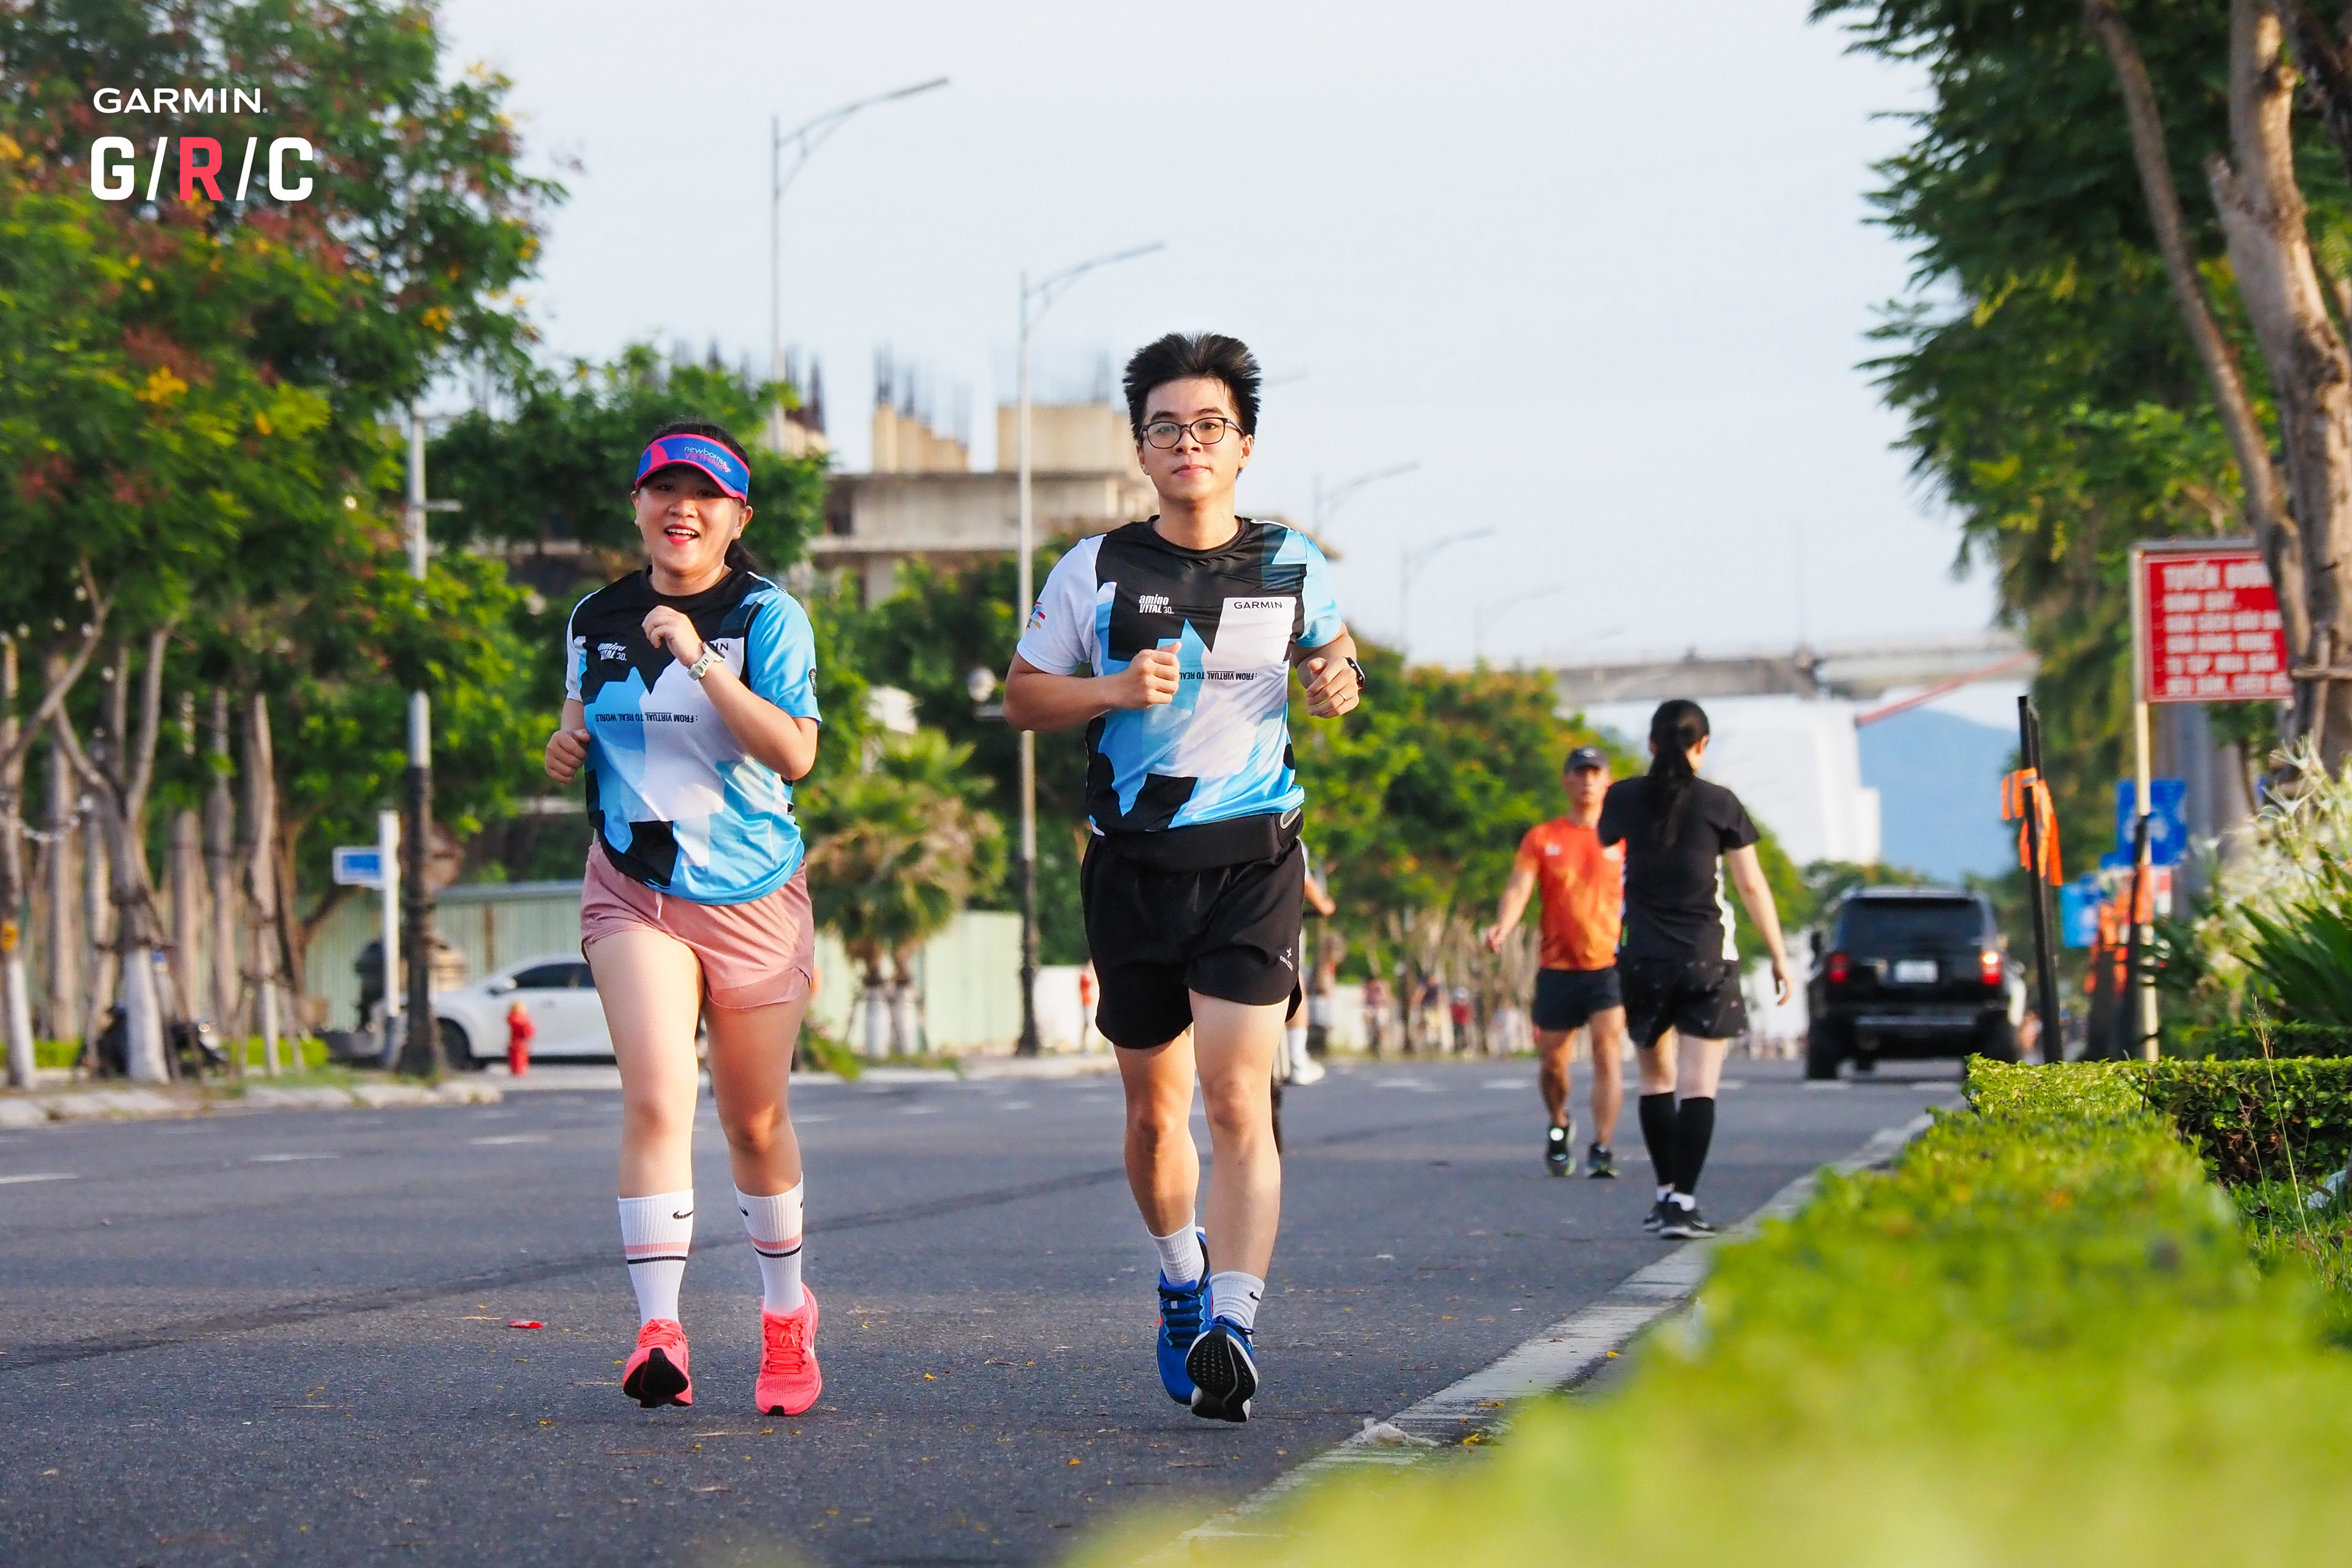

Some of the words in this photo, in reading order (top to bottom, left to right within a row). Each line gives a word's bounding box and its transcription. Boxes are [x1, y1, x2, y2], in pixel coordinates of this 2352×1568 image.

[684, 446, 723, 464] newborns
[1139, 594, 1169, 606] amino
[1139, 603, 1163, 614] VITAL
[1197, 671, 1205, 680] TO
[1207, 671, 1234, 680] VIRTUAL
[595, 714, 616, 722] WORLD
[617, 714, 633, 722] REAL
[635, 714, 644, 722] TO
[645, 713, 672, 722] VIRTUAL
[674, 714, 694, 723] FROM
